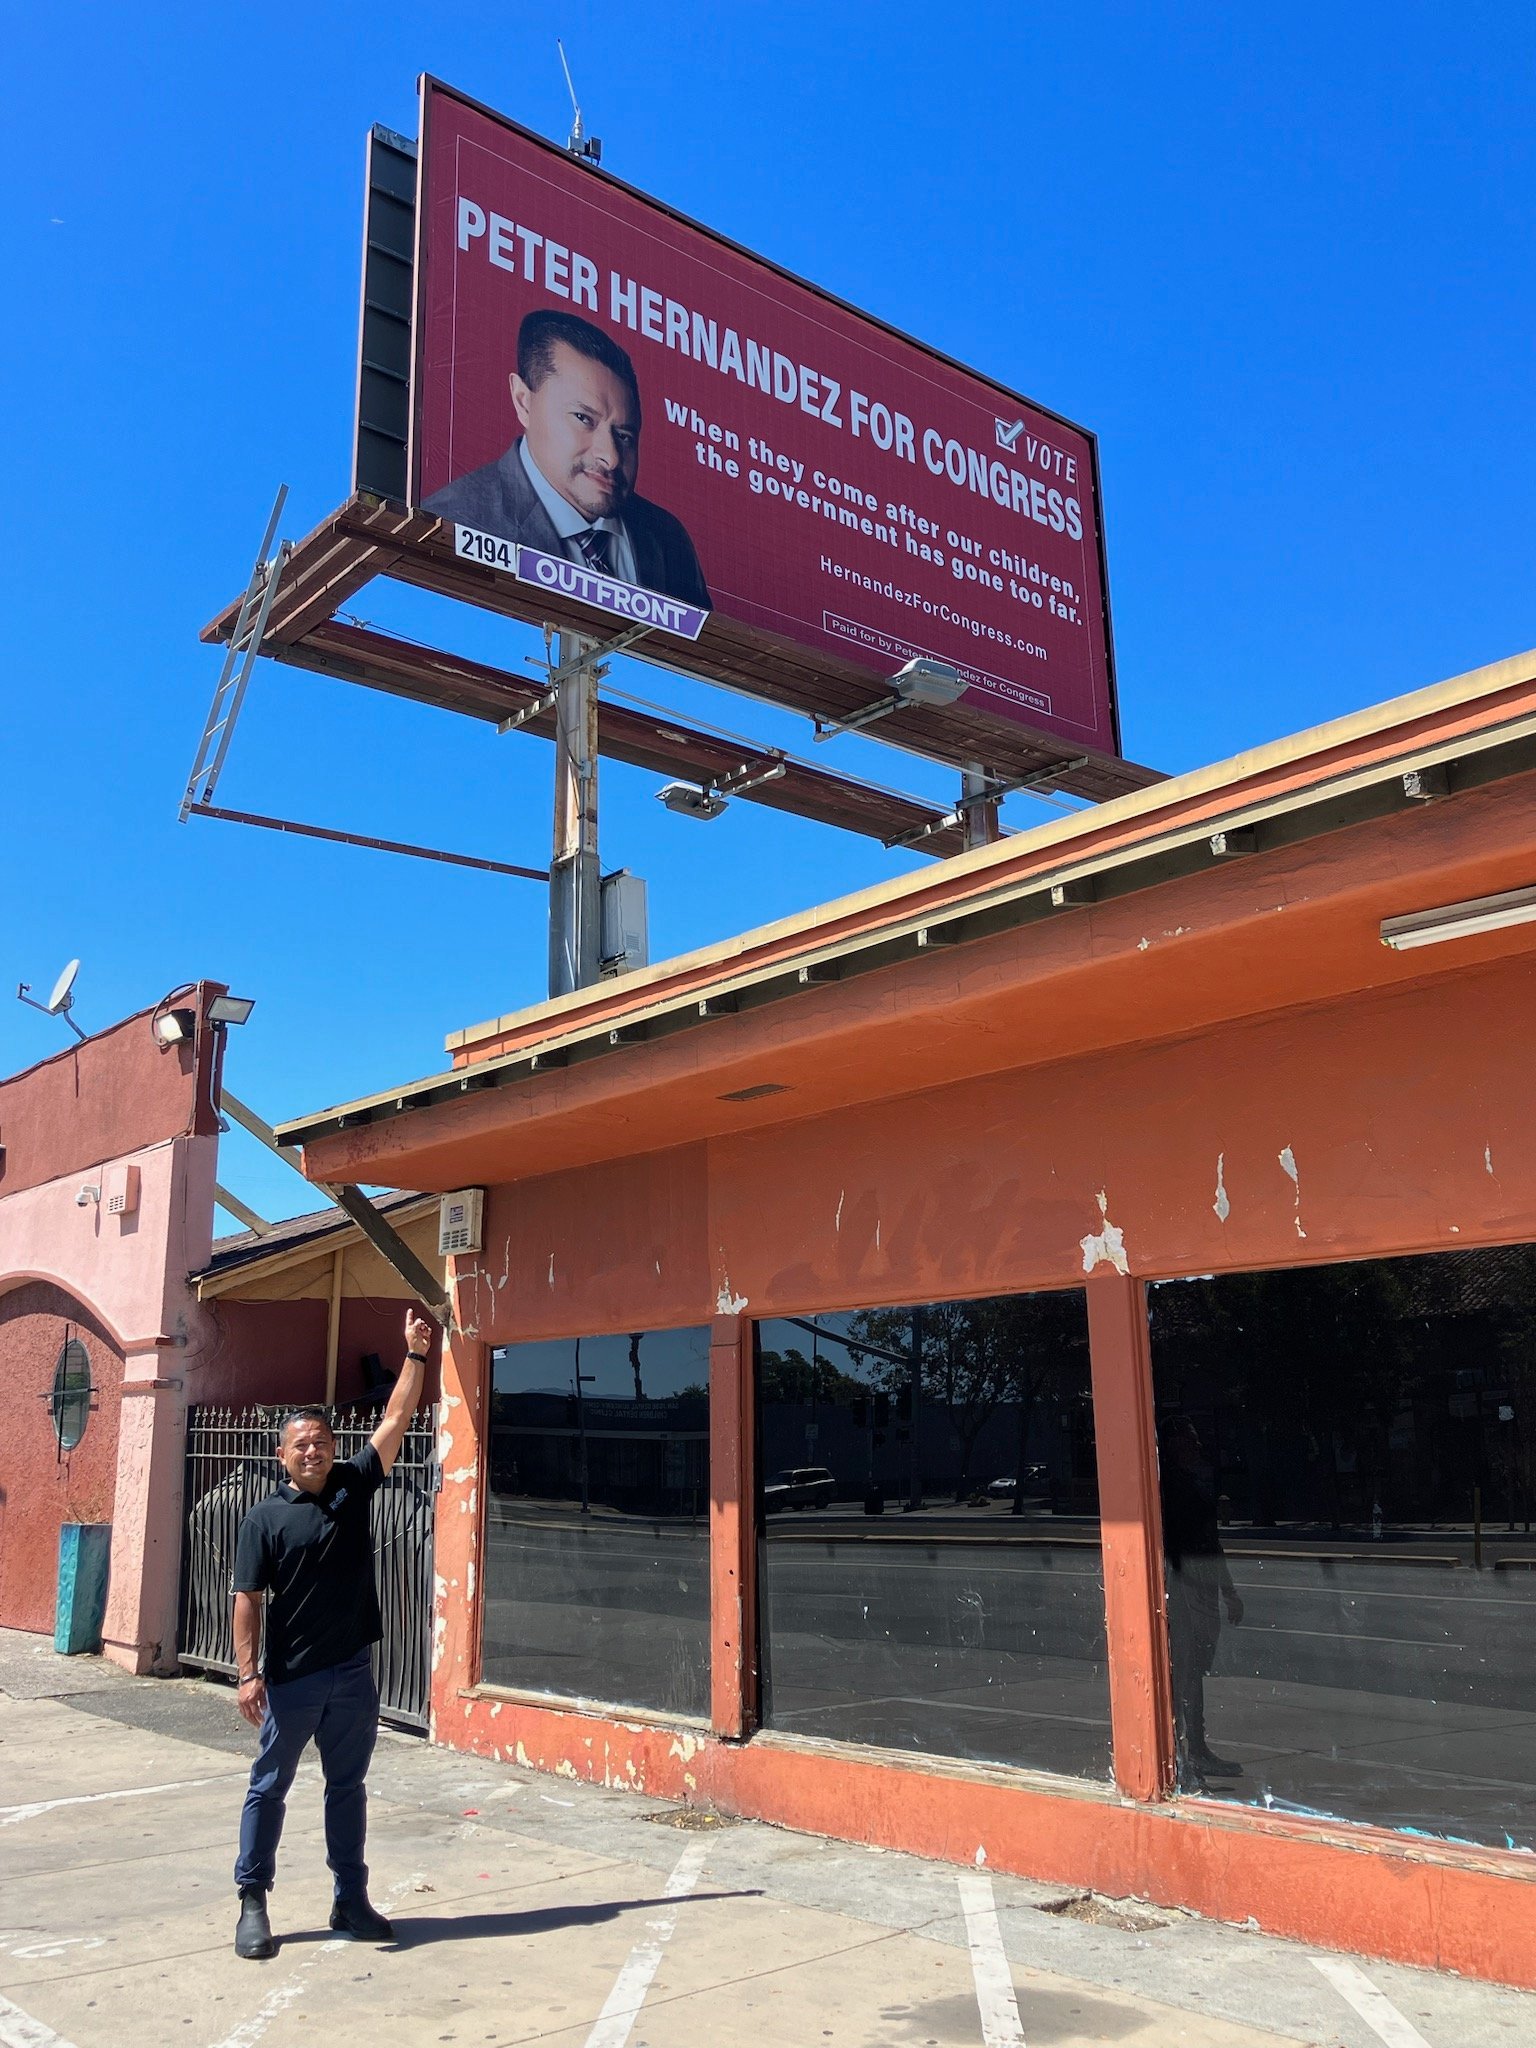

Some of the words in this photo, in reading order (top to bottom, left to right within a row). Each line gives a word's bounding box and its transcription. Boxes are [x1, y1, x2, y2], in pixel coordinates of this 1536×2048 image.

[458, 195, 599, 313] PETER
[611, 270, 843, 429] HERNANDEZ
[850, 390, 916, 464] FOR
[923, 428, 1084, 541] CONGRESS
[664, 398, 740, 451] When
[748, 437, 805, 483] they
[813, 470, 878, 512] come
[886, 503, 940, 539] after
[946, 530, 983, 558] our
[989, 549, 1080, 604] children,
[1026, 436, 1077, 484] VOTE
[462, 530, 511, 568] 2194
[695, 441, 740, 479] the
[748, 468, 899, 548] government
[905, 531, 945, 567] has
[951, 557, 1004, 593] gone
[1009, 578, 1043, 609] too
[1048, 594, 1082, 626] far.
[535, 557, 688, 631] OUTFRONT
[820, 555, 1048, 661] HernandezForCongress.com
[832, 619, 857, 637] Paid
[859, 629, 876, 643] for
[878, 636, 892, 650] by
[982, 676, 998, 690] for
[999, 682, 1045, 708] Congress
